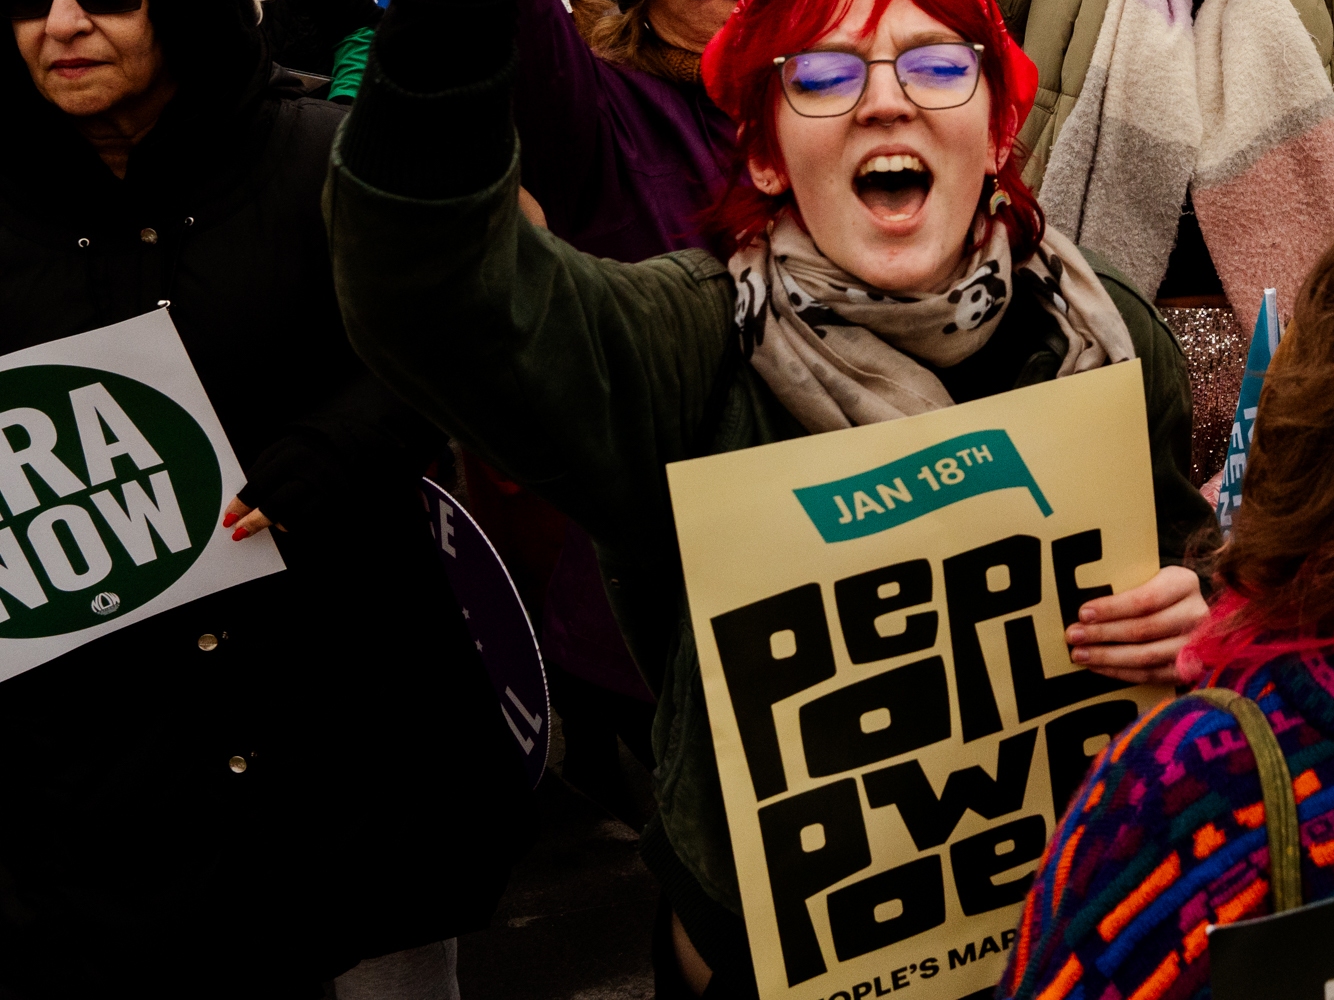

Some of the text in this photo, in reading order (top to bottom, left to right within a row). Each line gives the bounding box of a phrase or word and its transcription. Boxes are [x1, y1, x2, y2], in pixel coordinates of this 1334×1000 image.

[0, 382, 164, 522] RA
[833, 443, 994, 526] JAN 18TH
[947, 928, 1018, 971] MAR
